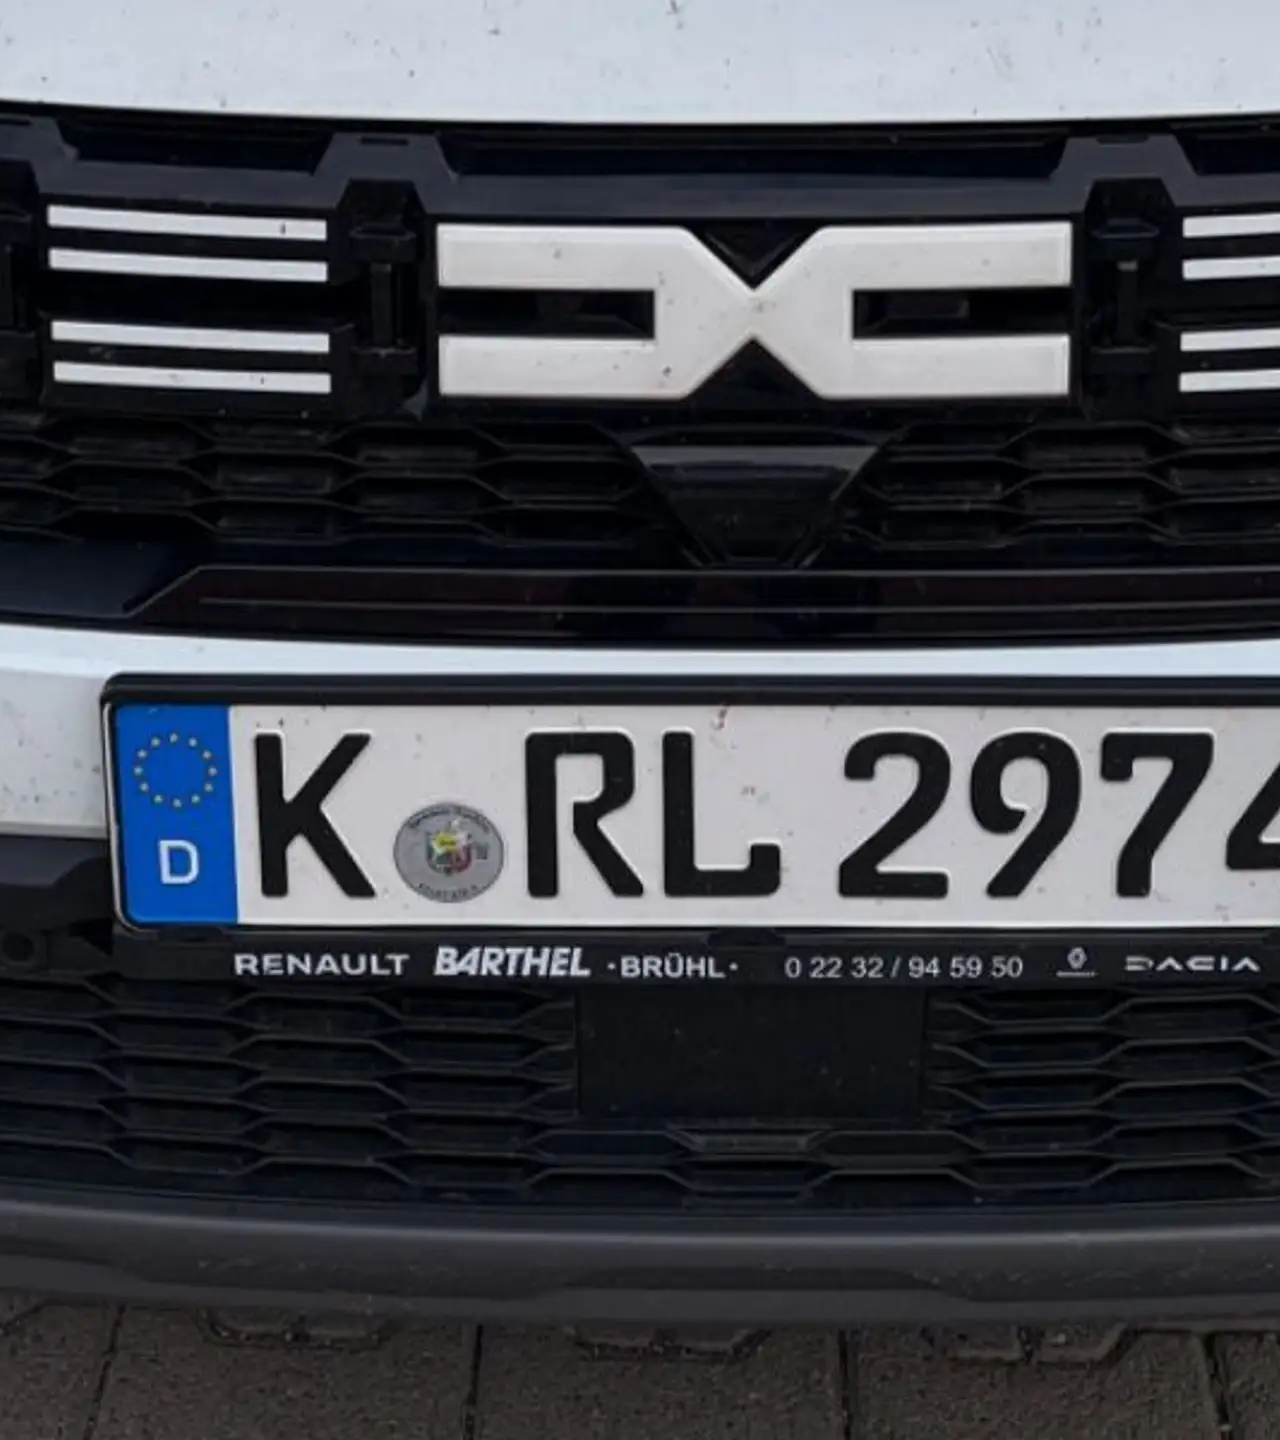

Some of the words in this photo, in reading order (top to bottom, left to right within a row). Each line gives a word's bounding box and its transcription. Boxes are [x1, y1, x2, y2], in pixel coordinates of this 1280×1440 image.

[253, 733, 377, 899] K
[524, 731, 782, 899] RL
[159, 840, 199, 884] D
[233, 953, 410, 976] RENAULT
[432, 946, 591, 977] BARTHEL
[785, 957, 802, 978] 0
[809, 957, 843, 978] 22
[851, 957, 885, 978] 32
[908, 957, 940, 979] 94
[949, 957, 983, 978] 59
[991, 957, 1024, 979] 50
[1124, 955, 1261, 973] DACIA
